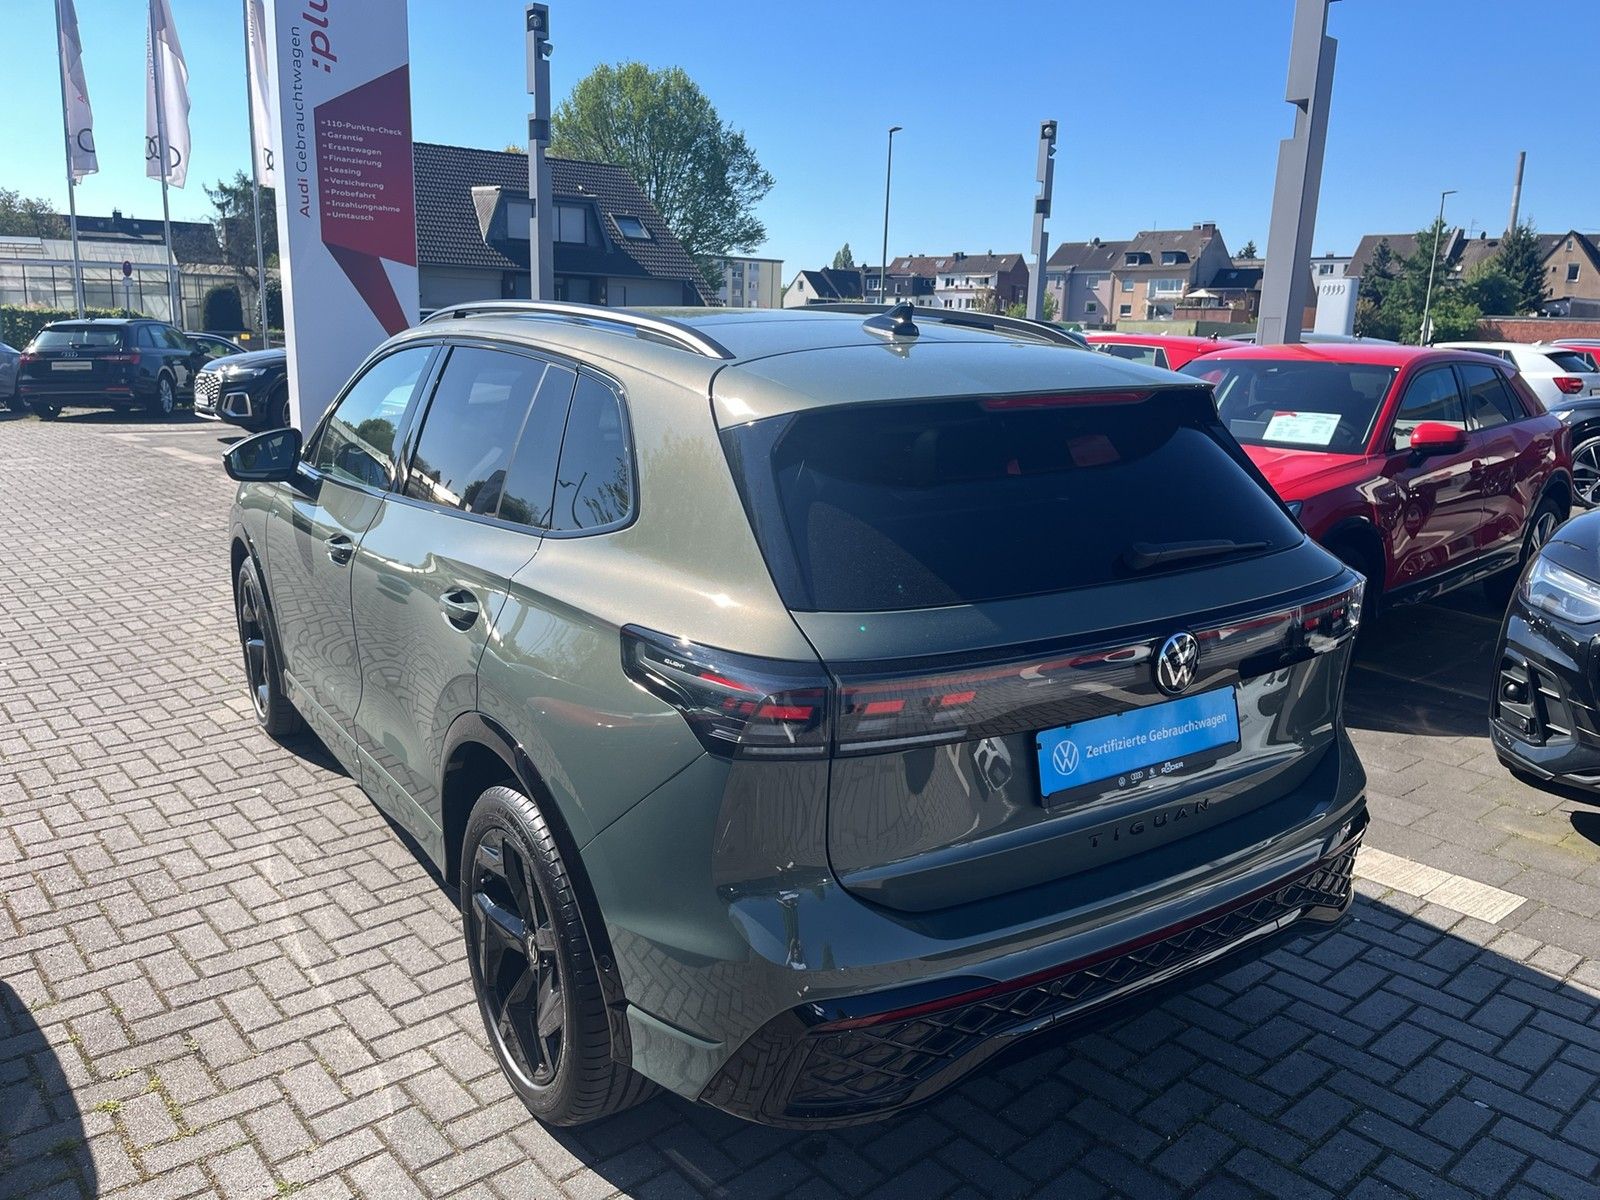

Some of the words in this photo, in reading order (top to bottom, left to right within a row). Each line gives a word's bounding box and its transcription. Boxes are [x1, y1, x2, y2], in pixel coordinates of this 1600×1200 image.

[291, 26, 307, 173] Gebrauchtwagen
[326, 119, 402, 136] 110-Punkte-Check
[327, 131, 364, 142] Garantie
[328, 143, 382, 156] Ersatzwagen
[328, 154, 382, 168] Finanzierung
[329, 166, 362, 177] Leasing
[330, 177, 384, 190] Versicherung
[298, 178, 310, 218] Audi
[331, 188, 376, 199] Probefahrt
[331, 200, 401, 213] Inzahlungnahme
[332, 211, 374, 221] Umtausch
[1086, 734, 1147, 758] Zertifizierte
[1149, 713, 1227, 742] Gebrauchtwagen
[1088, 798, 1209, 847] TIGUAN
